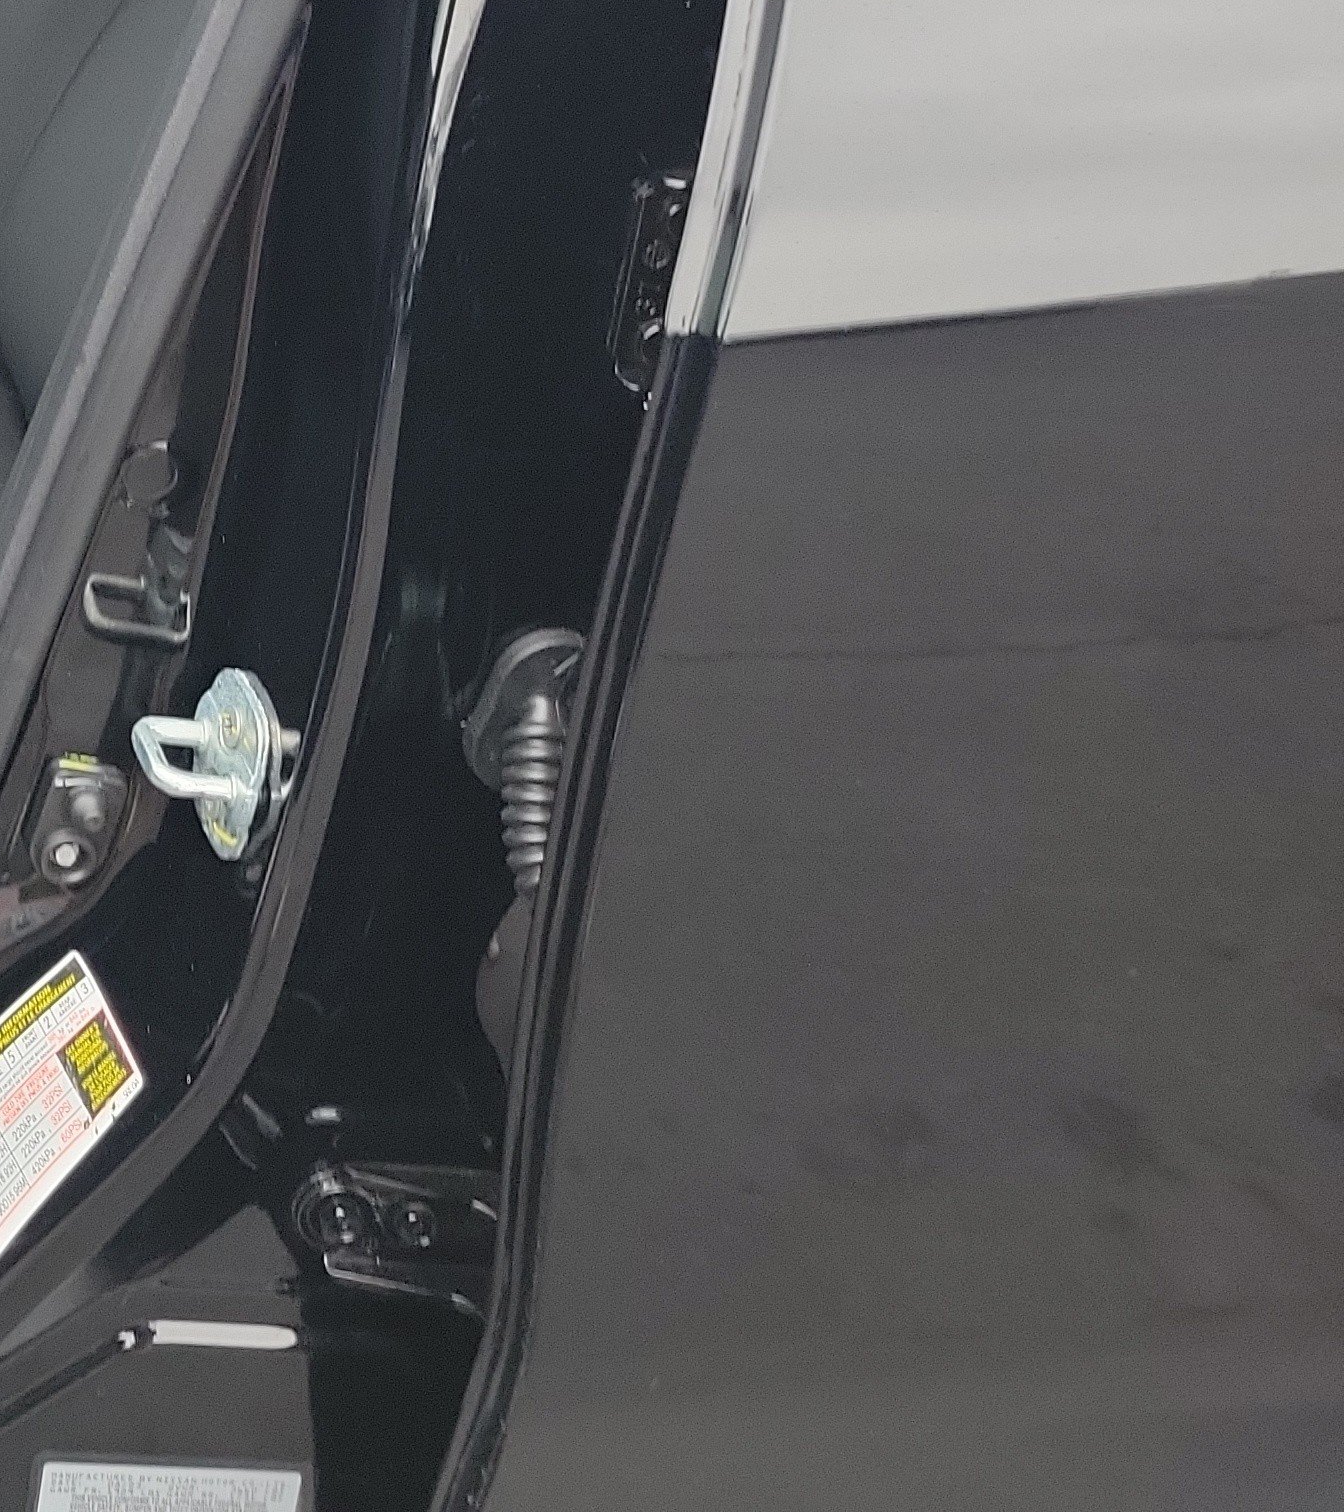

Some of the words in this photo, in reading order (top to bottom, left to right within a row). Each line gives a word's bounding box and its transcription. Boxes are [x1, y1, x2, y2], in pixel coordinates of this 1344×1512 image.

[79, 980, 89, 996] 3
[41, 1013, 53, 1030] 2
[6, 1048, 17, 1065] 5
[10, 1109, 37, 1143] 220kPa
[19, 1125, 46, 1160] 220kPa
